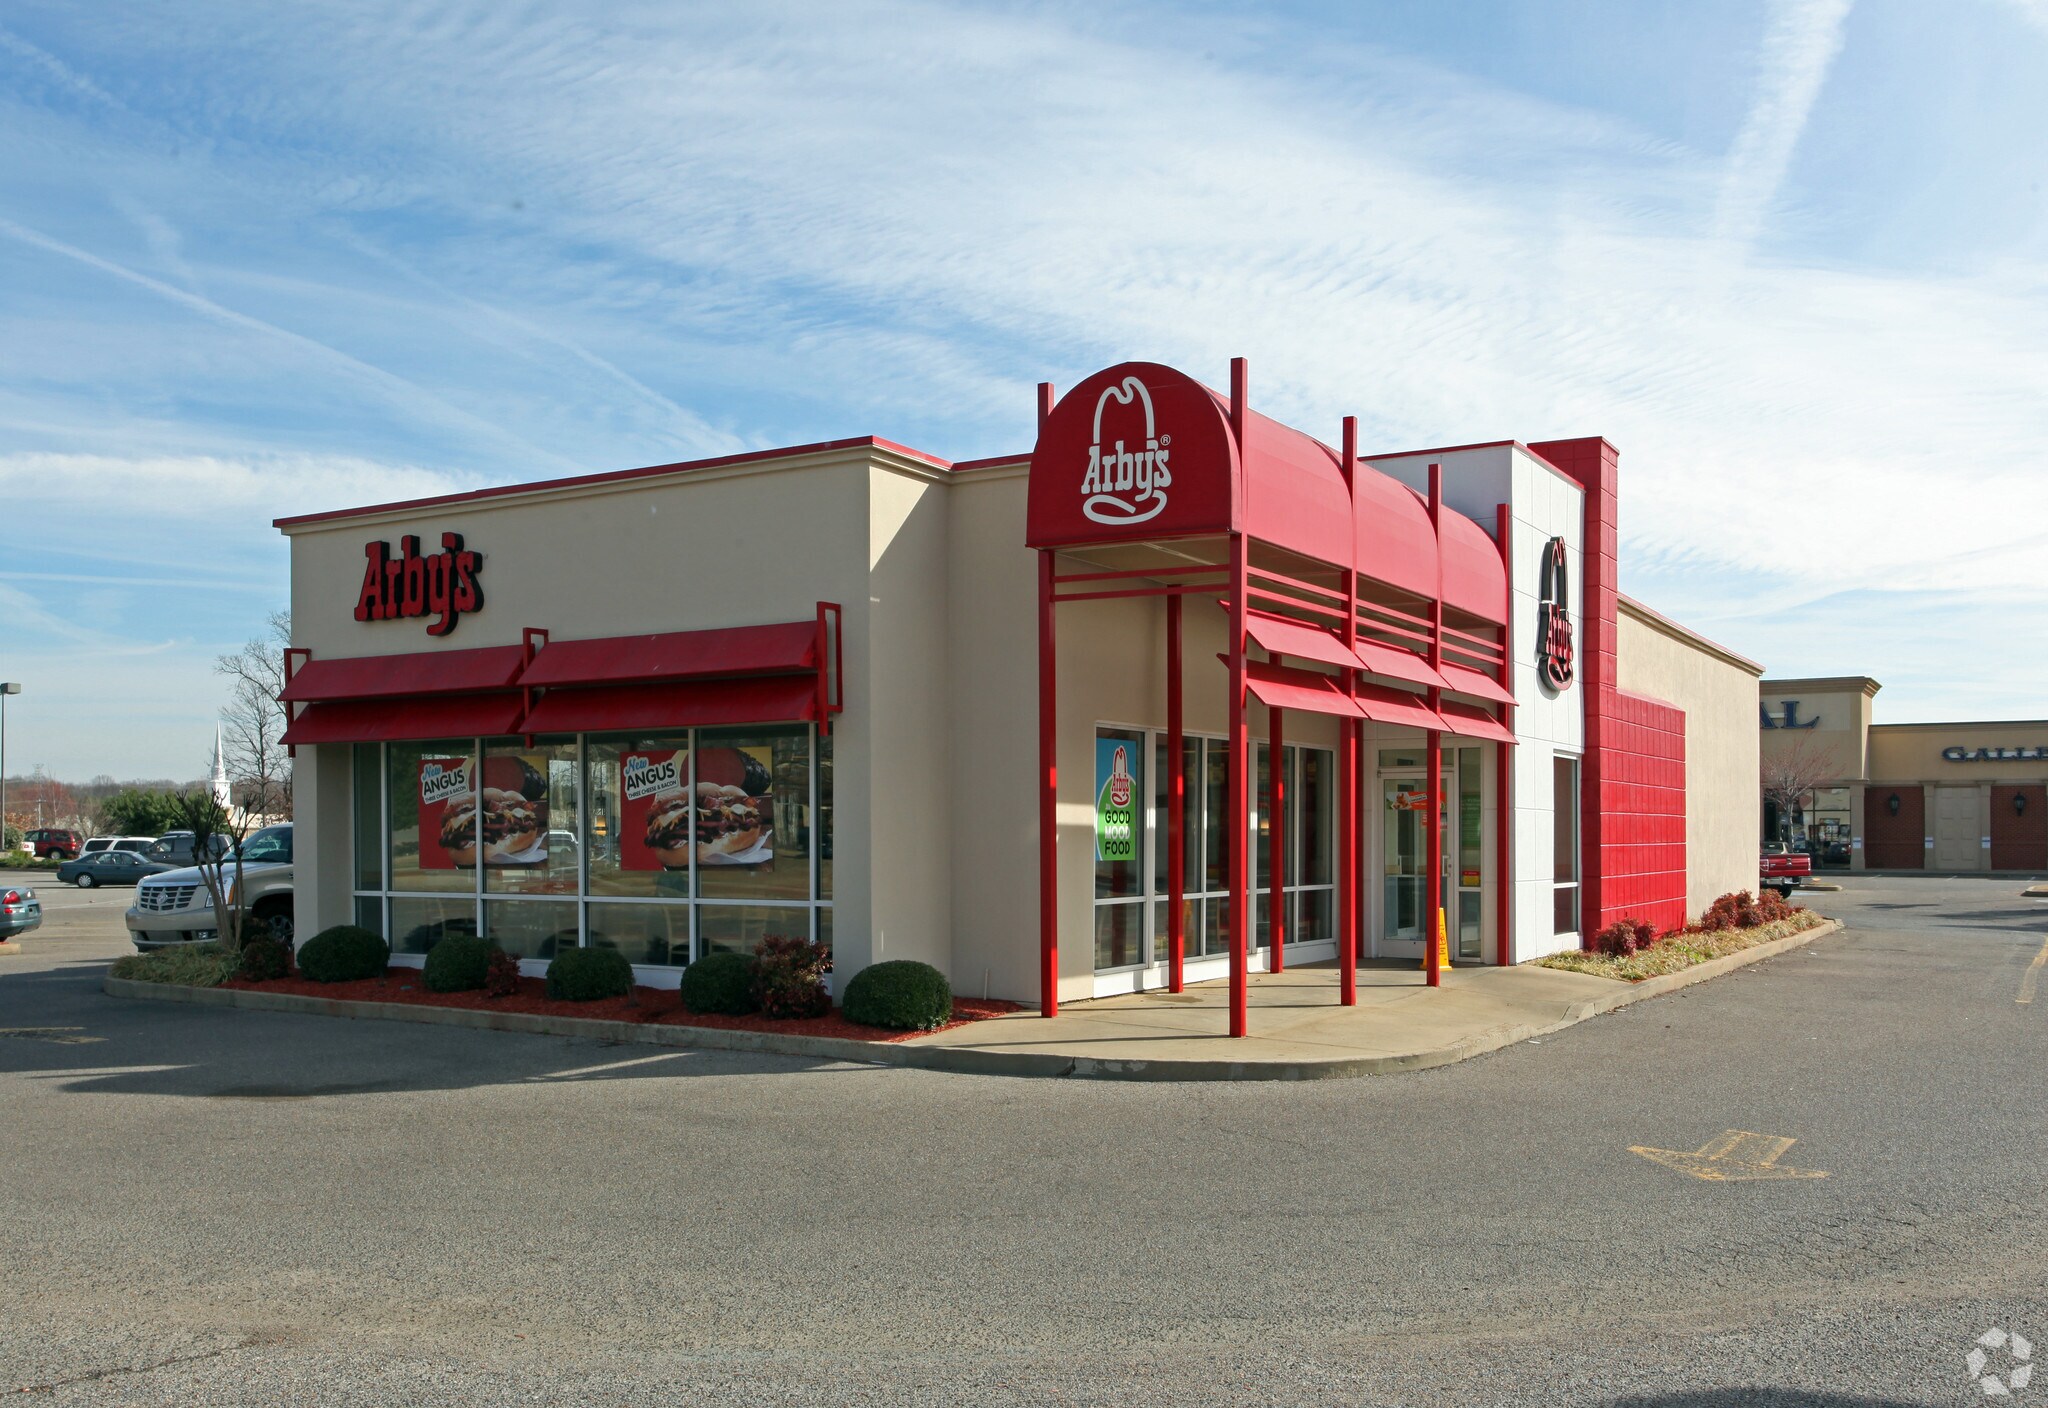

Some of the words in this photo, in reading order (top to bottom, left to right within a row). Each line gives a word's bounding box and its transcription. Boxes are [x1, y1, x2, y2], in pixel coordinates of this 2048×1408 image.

[1081, 440, 1172, 502] Arby's
[354, 532, 484, 636] Arby's
[422, 765, 441, 781] New
[625, 758, 647, 775] New
[423, 769, 465, 796] ANGUS
[627, 762, 675, 791] ANGUS
[628, 790, 641, 799] THREE
[641, 785, 657, 795] CHEESE
[661, 780, 677, 789] BACON
[1105, 810, 1130, 824] GOOD
[1105, 825, 1130, 839] MOOD
[1104, 840, 1130, 855] FOOD
